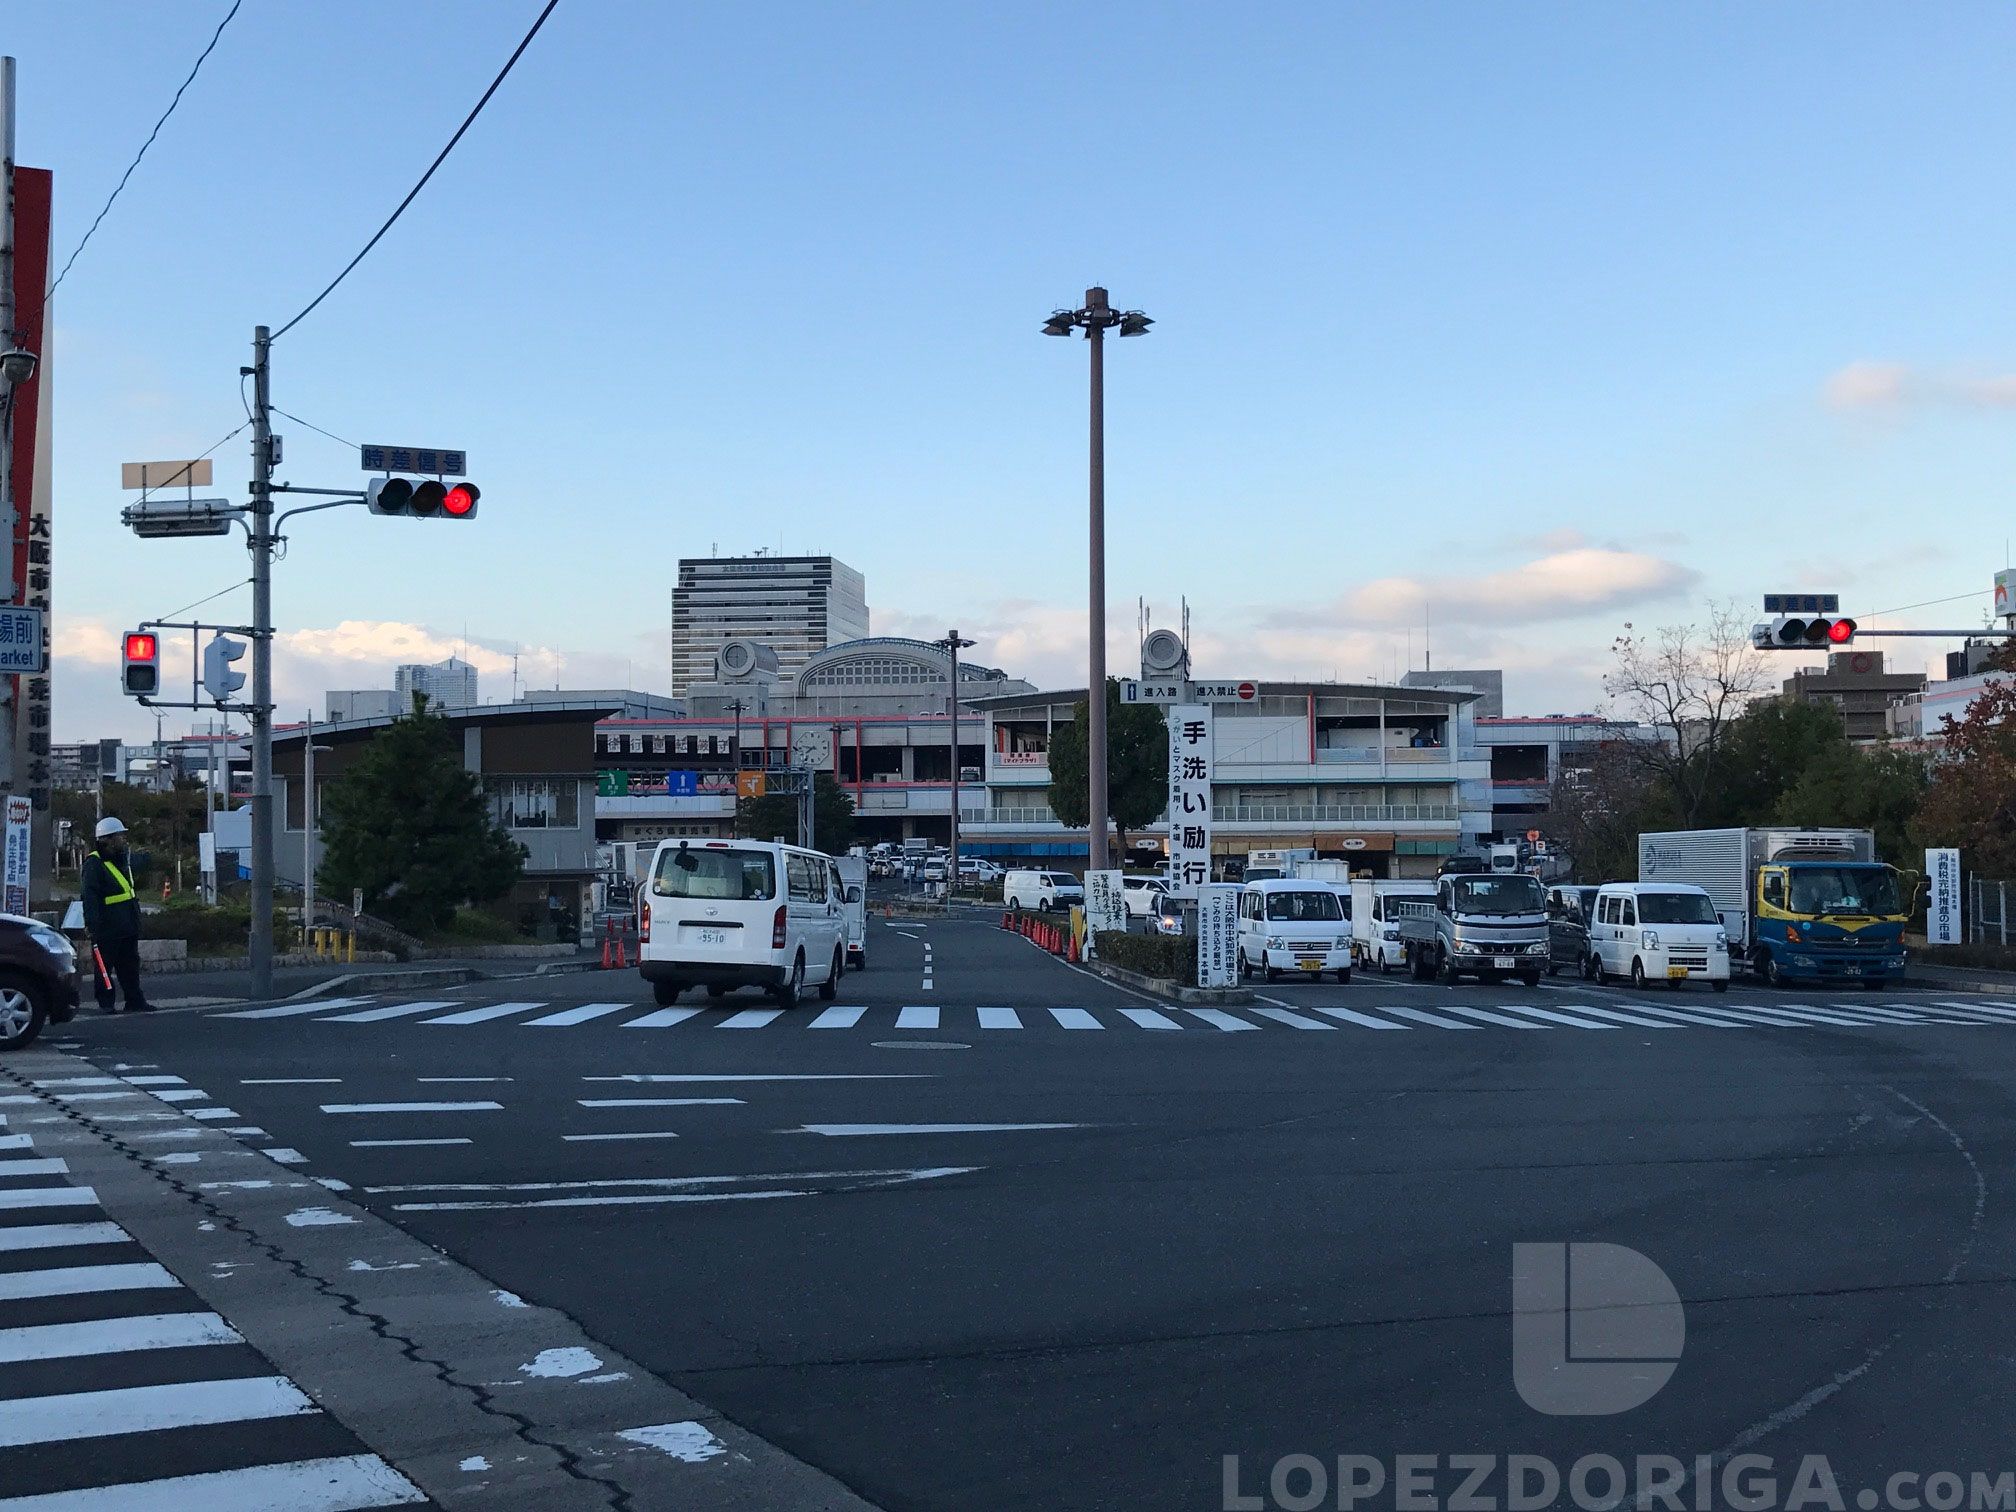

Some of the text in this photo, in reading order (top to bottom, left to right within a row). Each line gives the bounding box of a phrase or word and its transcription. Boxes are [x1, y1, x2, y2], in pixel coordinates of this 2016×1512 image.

[364, 448, 462, 473] 時差信号
[1144, 687, 1177, 697] 進入路
[1196, 686, 1236, 697] 進入禁止
[1182, 720, 1206, 885] 手洗い励行
